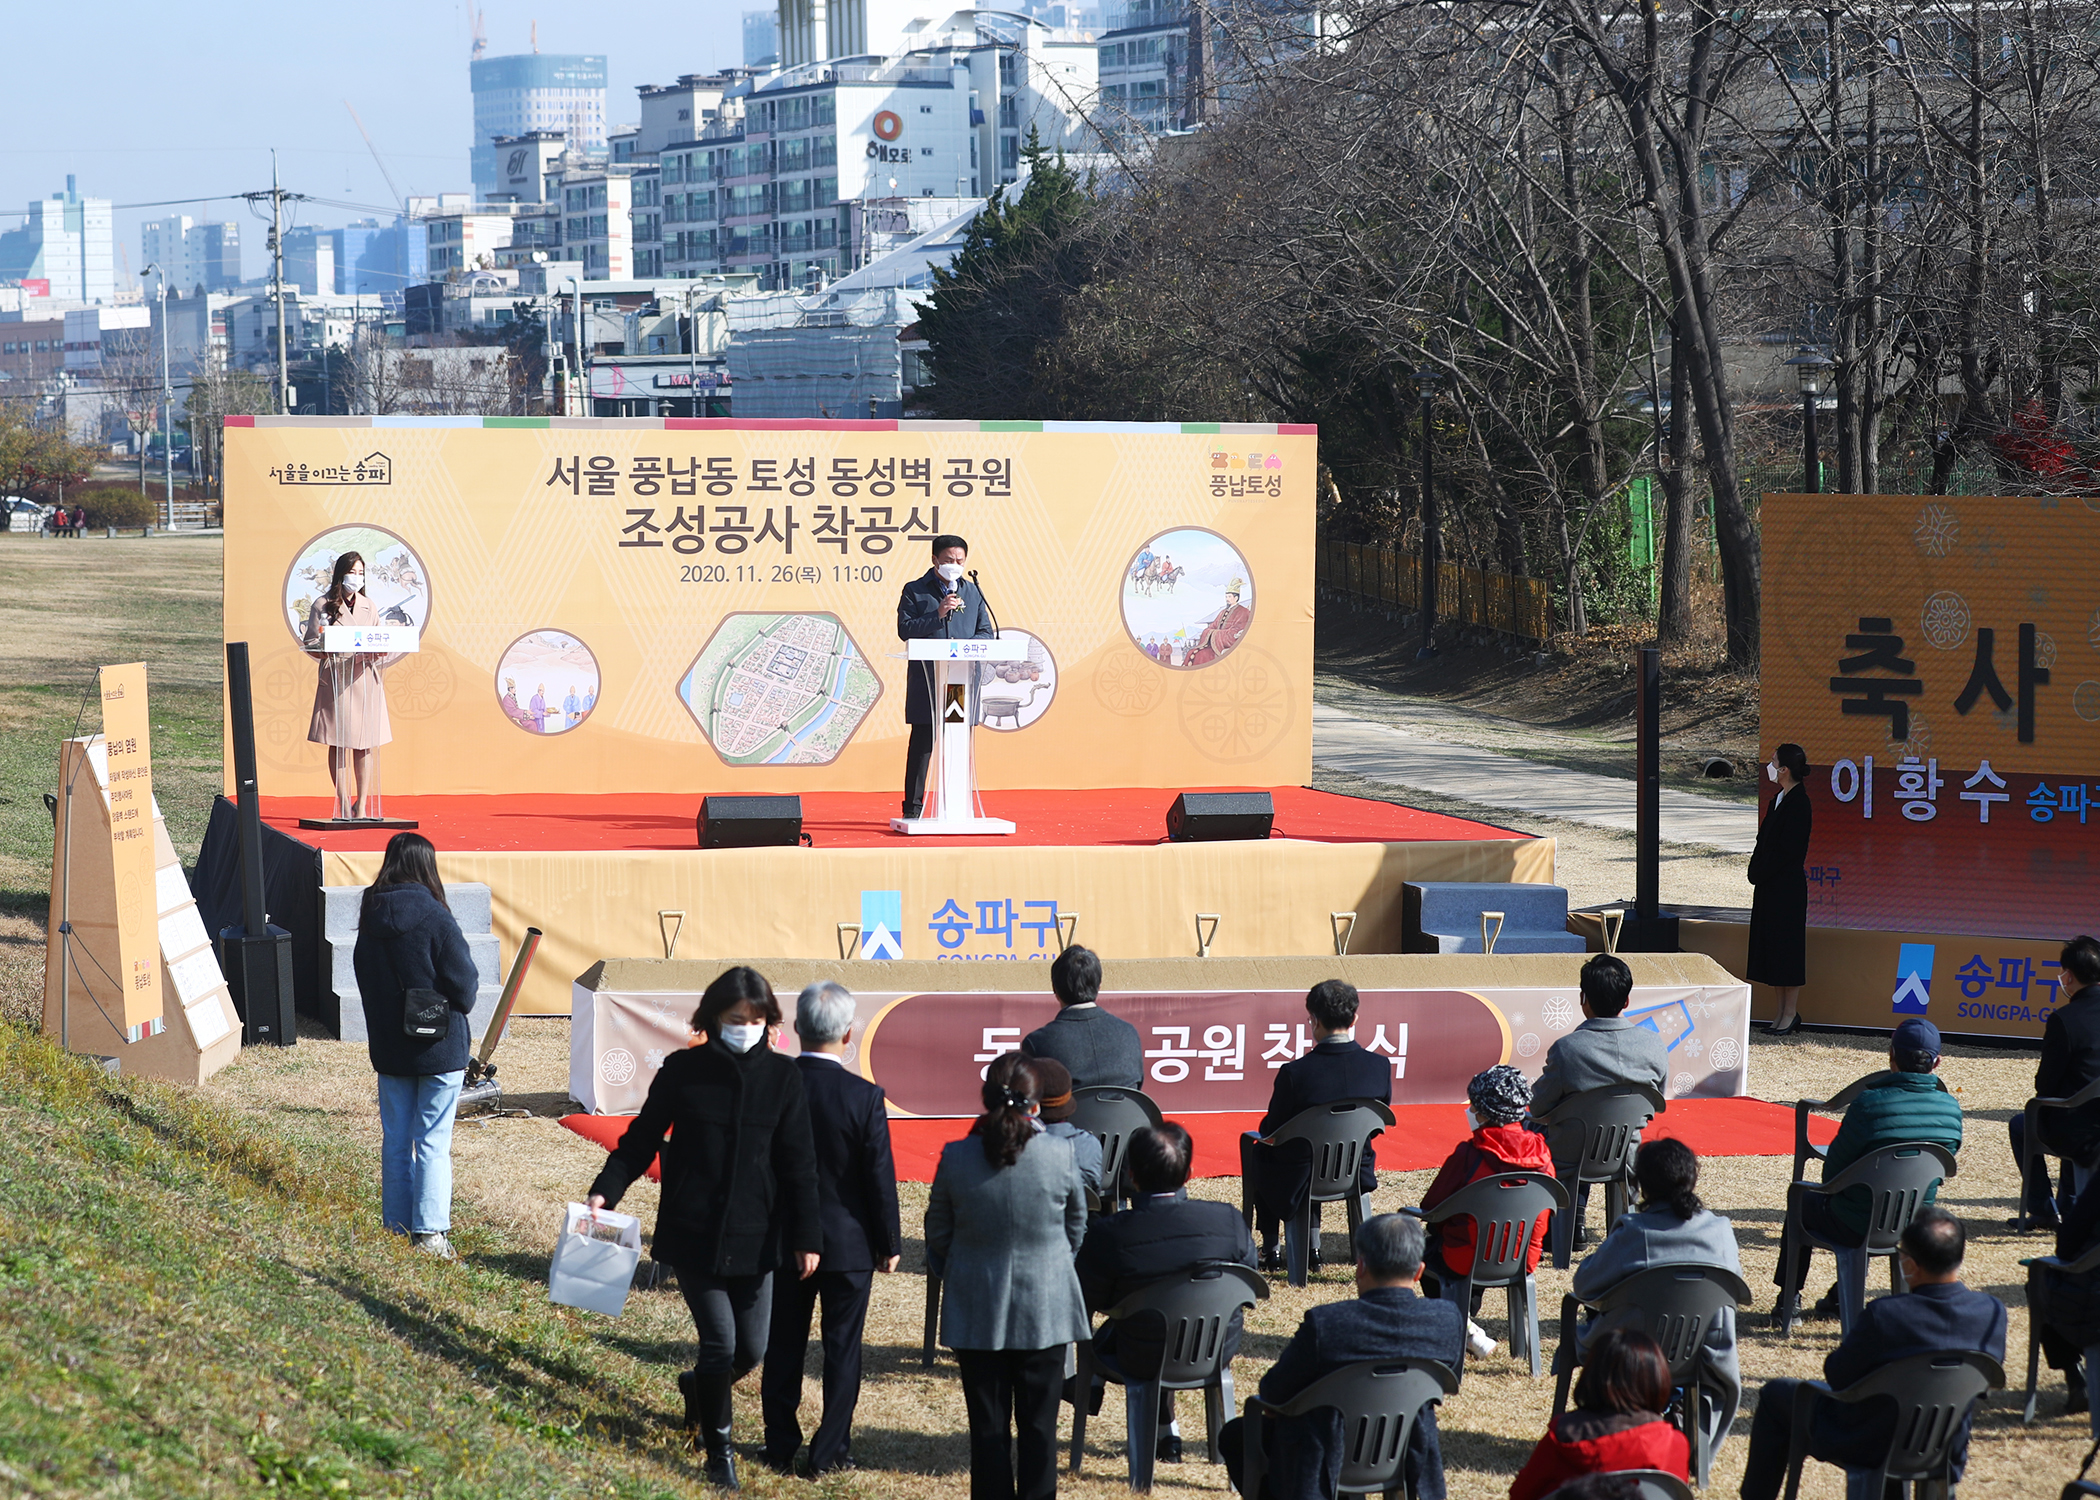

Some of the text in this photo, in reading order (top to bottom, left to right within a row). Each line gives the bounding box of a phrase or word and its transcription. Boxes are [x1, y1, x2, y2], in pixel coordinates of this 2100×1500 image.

[866, 140, 912, 164] 해오로
[546, 456, 1012, 497] 서울 풍납동 토성 동성벽 공원
[1209, 475, 1282, 498] 풍납토성
[618, 505, 939, 554] 조성공사 착공식
[832, 566, 883, 583] 11:00
[366, 633, 390, 643] 송파구
[963, 644, 988, 654] 송파구
[107, 738, 137, 757] 풍납의 염원
[2025, 782, 2100, 824] 송파
[1804, 866, 1842, 888] 파구
[928, 898, 1064, 949] 송파구
[135, 972, 151, 991] 풍납토성
[1955, 954, 2062, 1005] 송파구
[1957, 1002, 2056, 1024] SONGPA-G
[1144, 1021, 1408, 1083] 공원 착식
